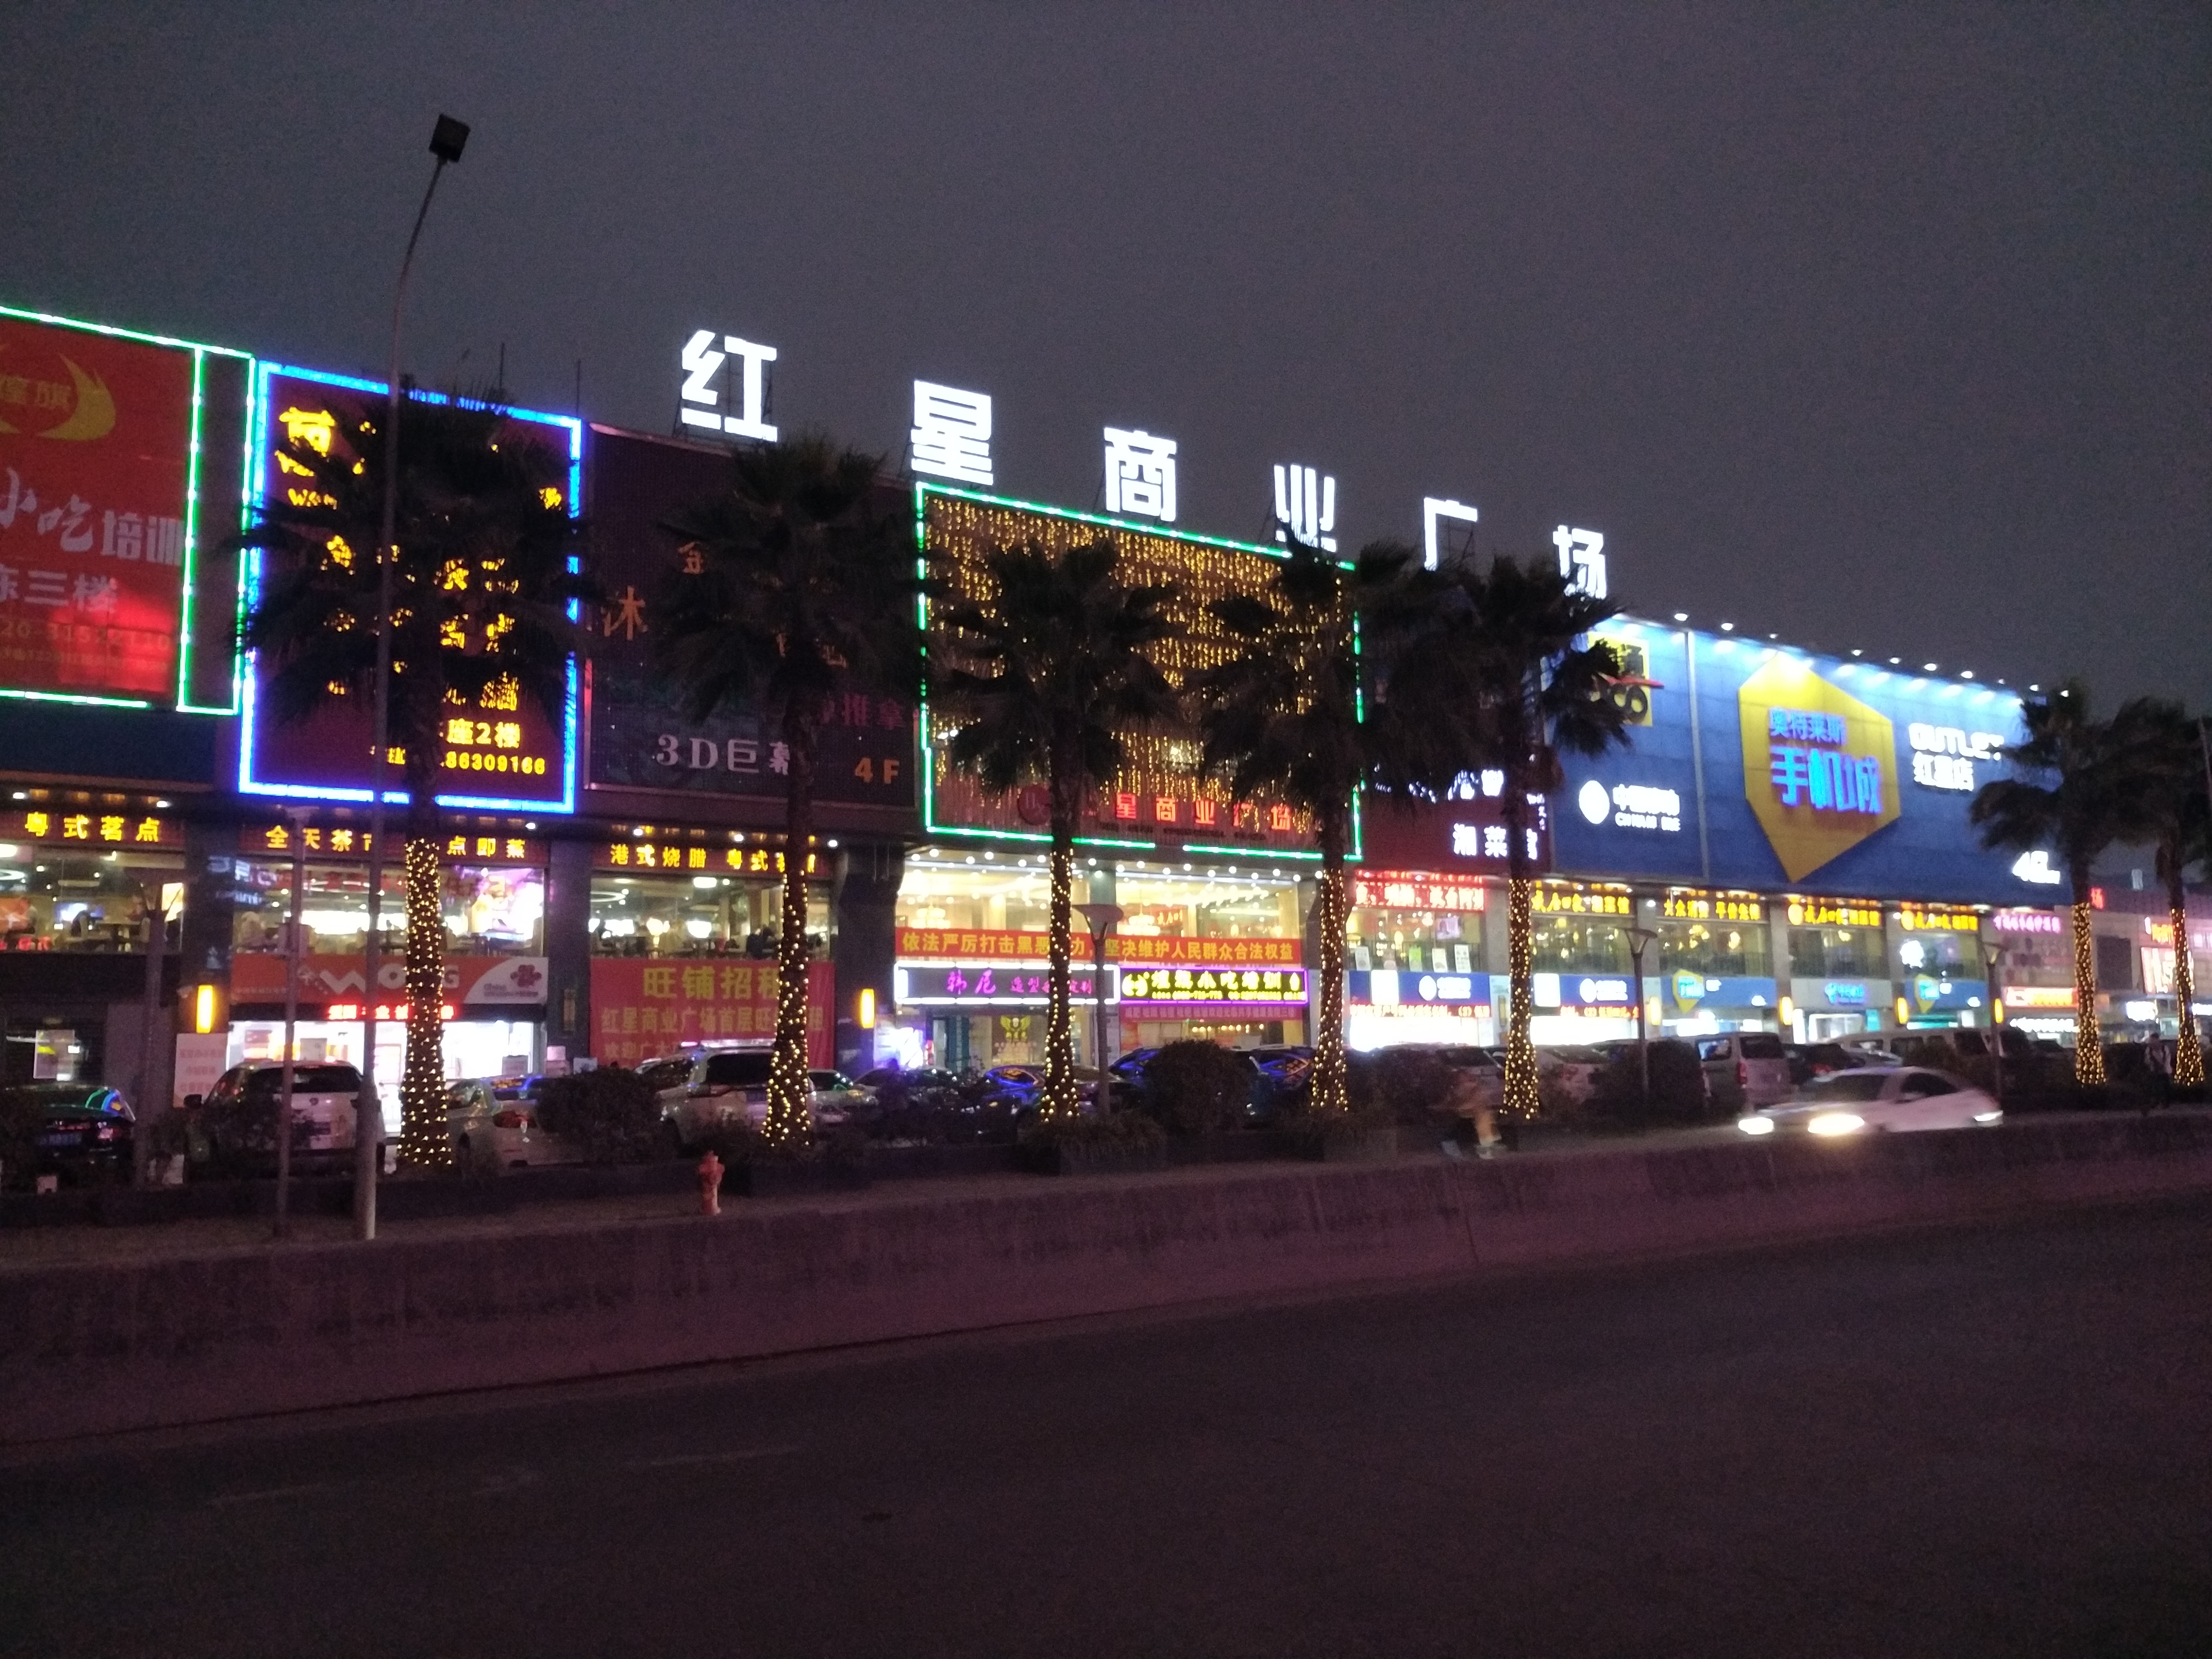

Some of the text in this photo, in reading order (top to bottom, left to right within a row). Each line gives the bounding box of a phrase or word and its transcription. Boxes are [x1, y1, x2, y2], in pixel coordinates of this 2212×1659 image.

[682, 330, 1608, 600] 红星商业广场
[1769, 708, 1846, 744] 奥特莱斯
[854, 756, 900, 785] 4F
[1771, 745, 1882, 814] 手机城
[610, 843, 707, 869] 港式烧腊
